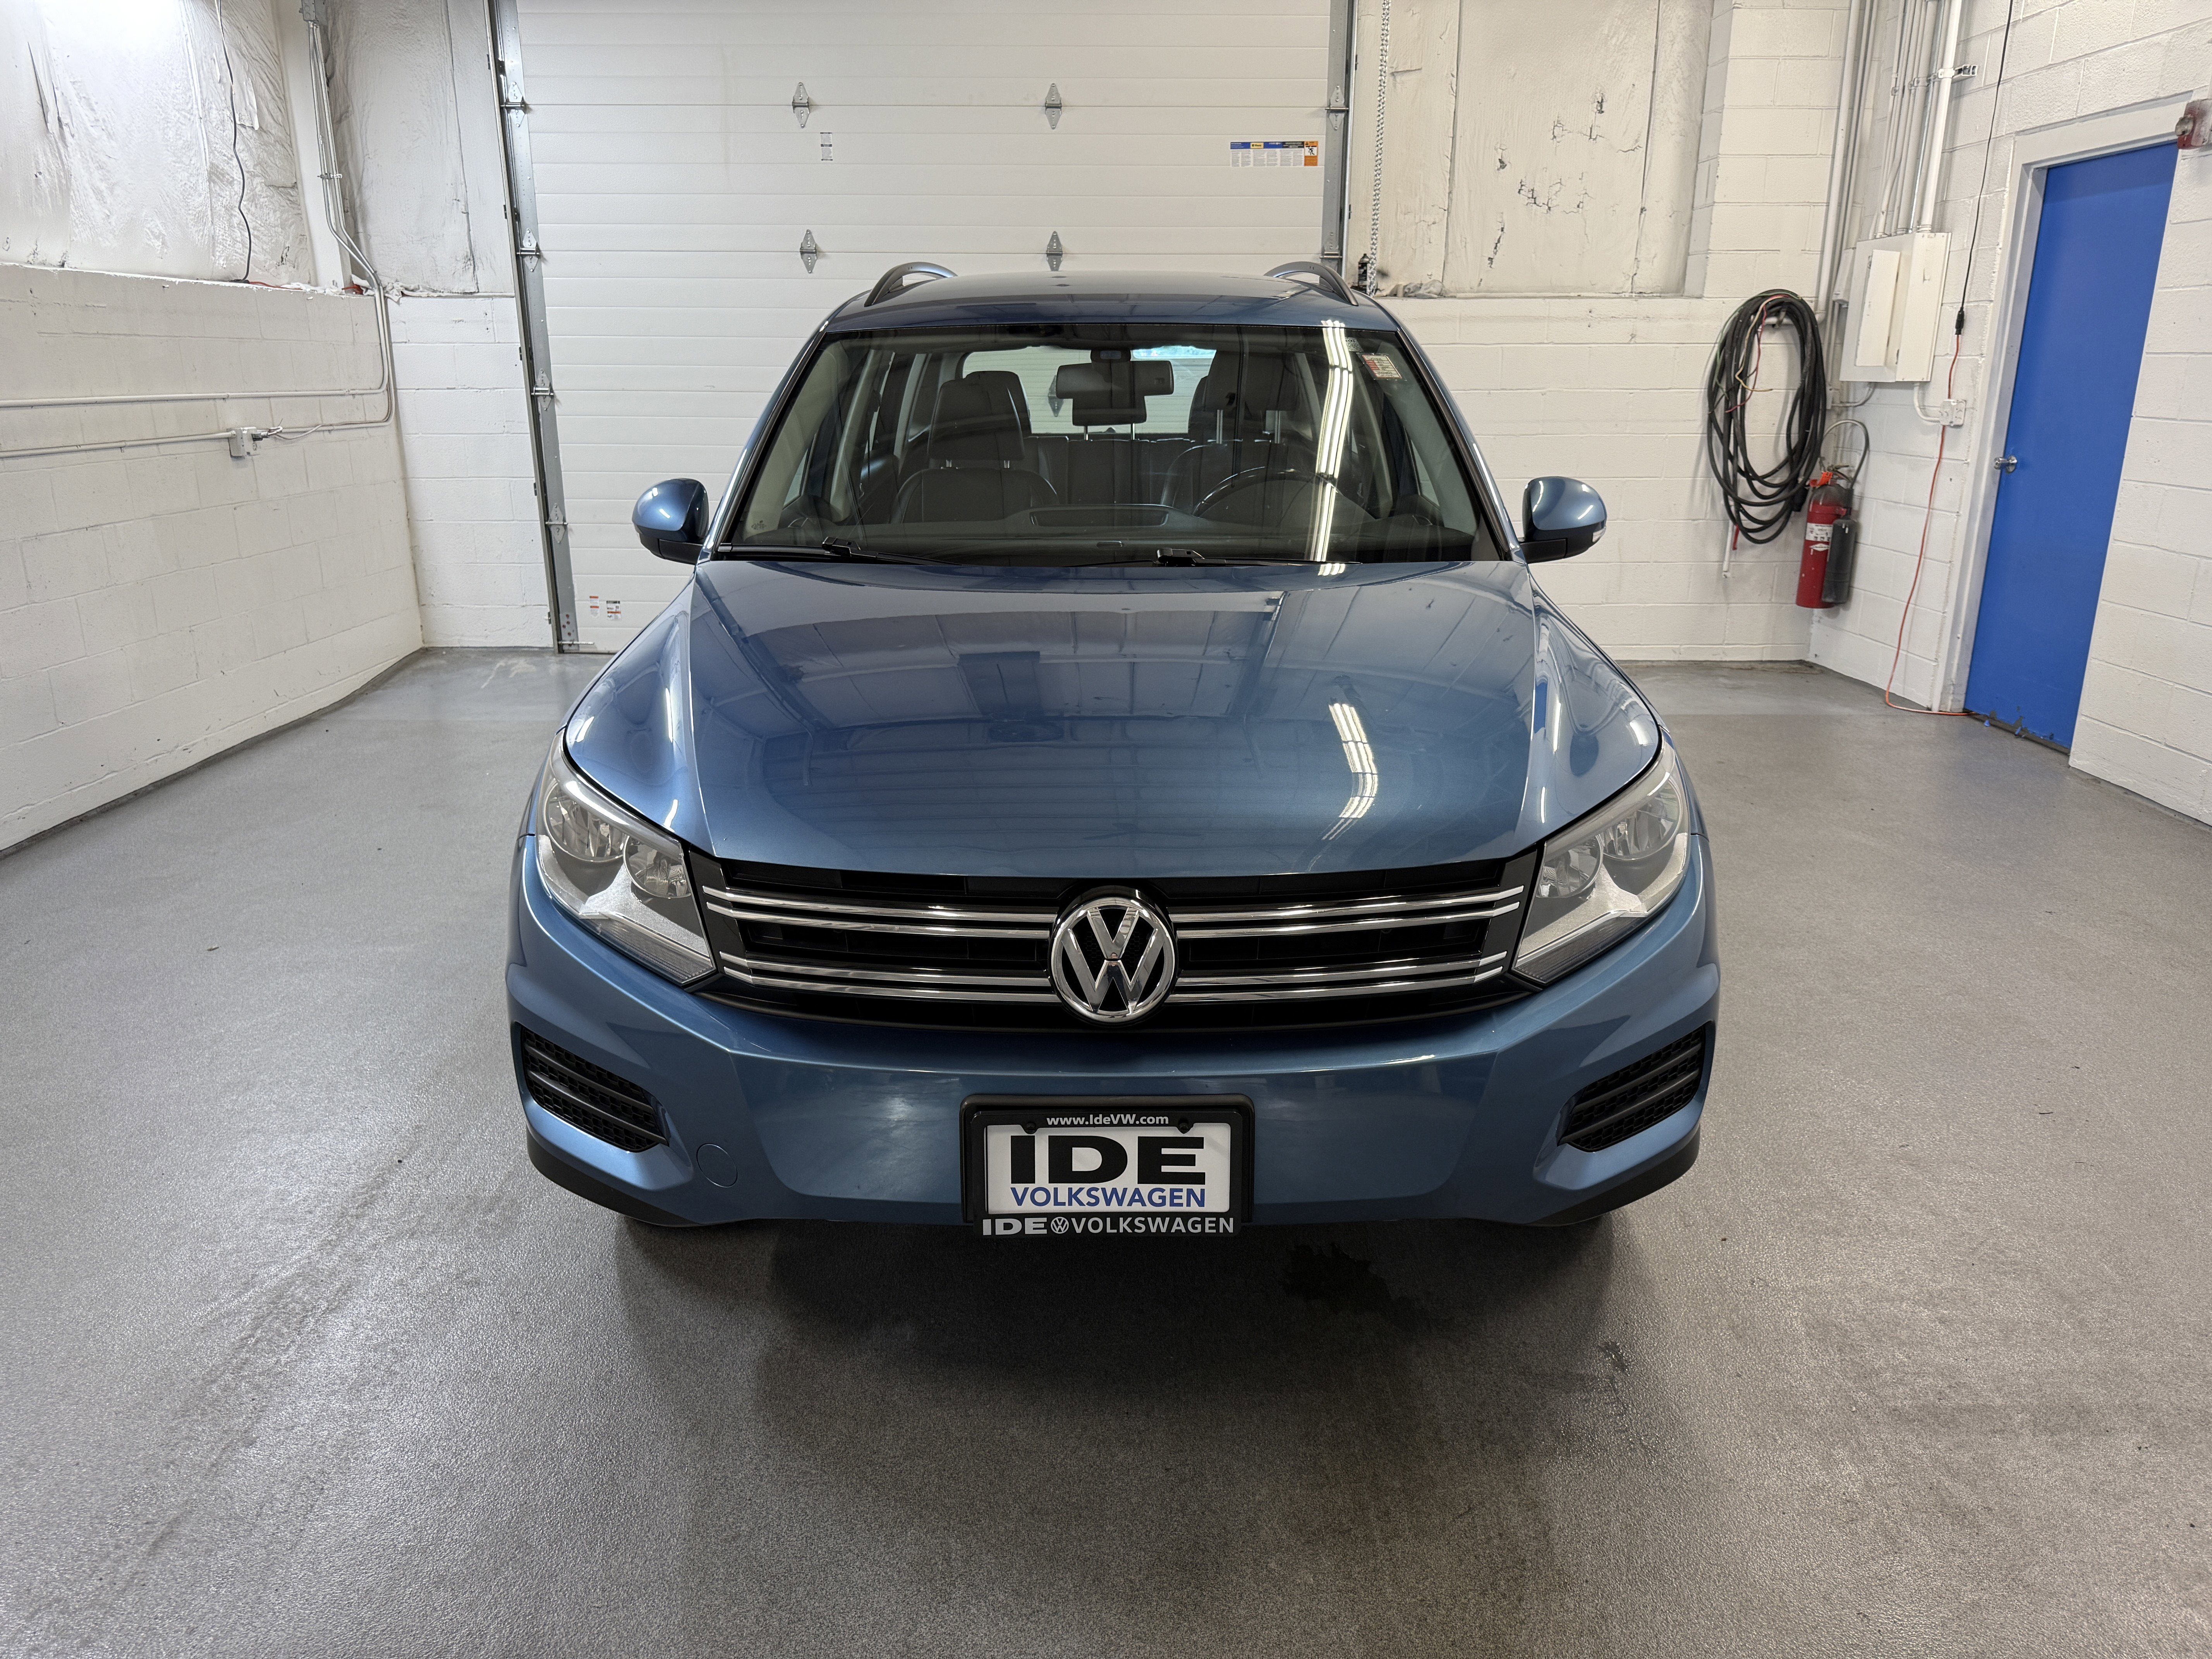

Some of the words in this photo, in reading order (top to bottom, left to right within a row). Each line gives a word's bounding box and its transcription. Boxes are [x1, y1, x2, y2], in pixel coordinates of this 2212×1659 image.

[1060, 905, 1166, 1015] VW
[1046, 1114, 1169, 1125] www.IdeVW.com
[1010, 1135, 1206, 1185] IDE
[1010, 1187, 1205, 1207] VOLKSWAGEN
[982, 1217, 1047, 1235] IDE
[1071, 1217, 1234, 1233] VOLKSWAGEN
